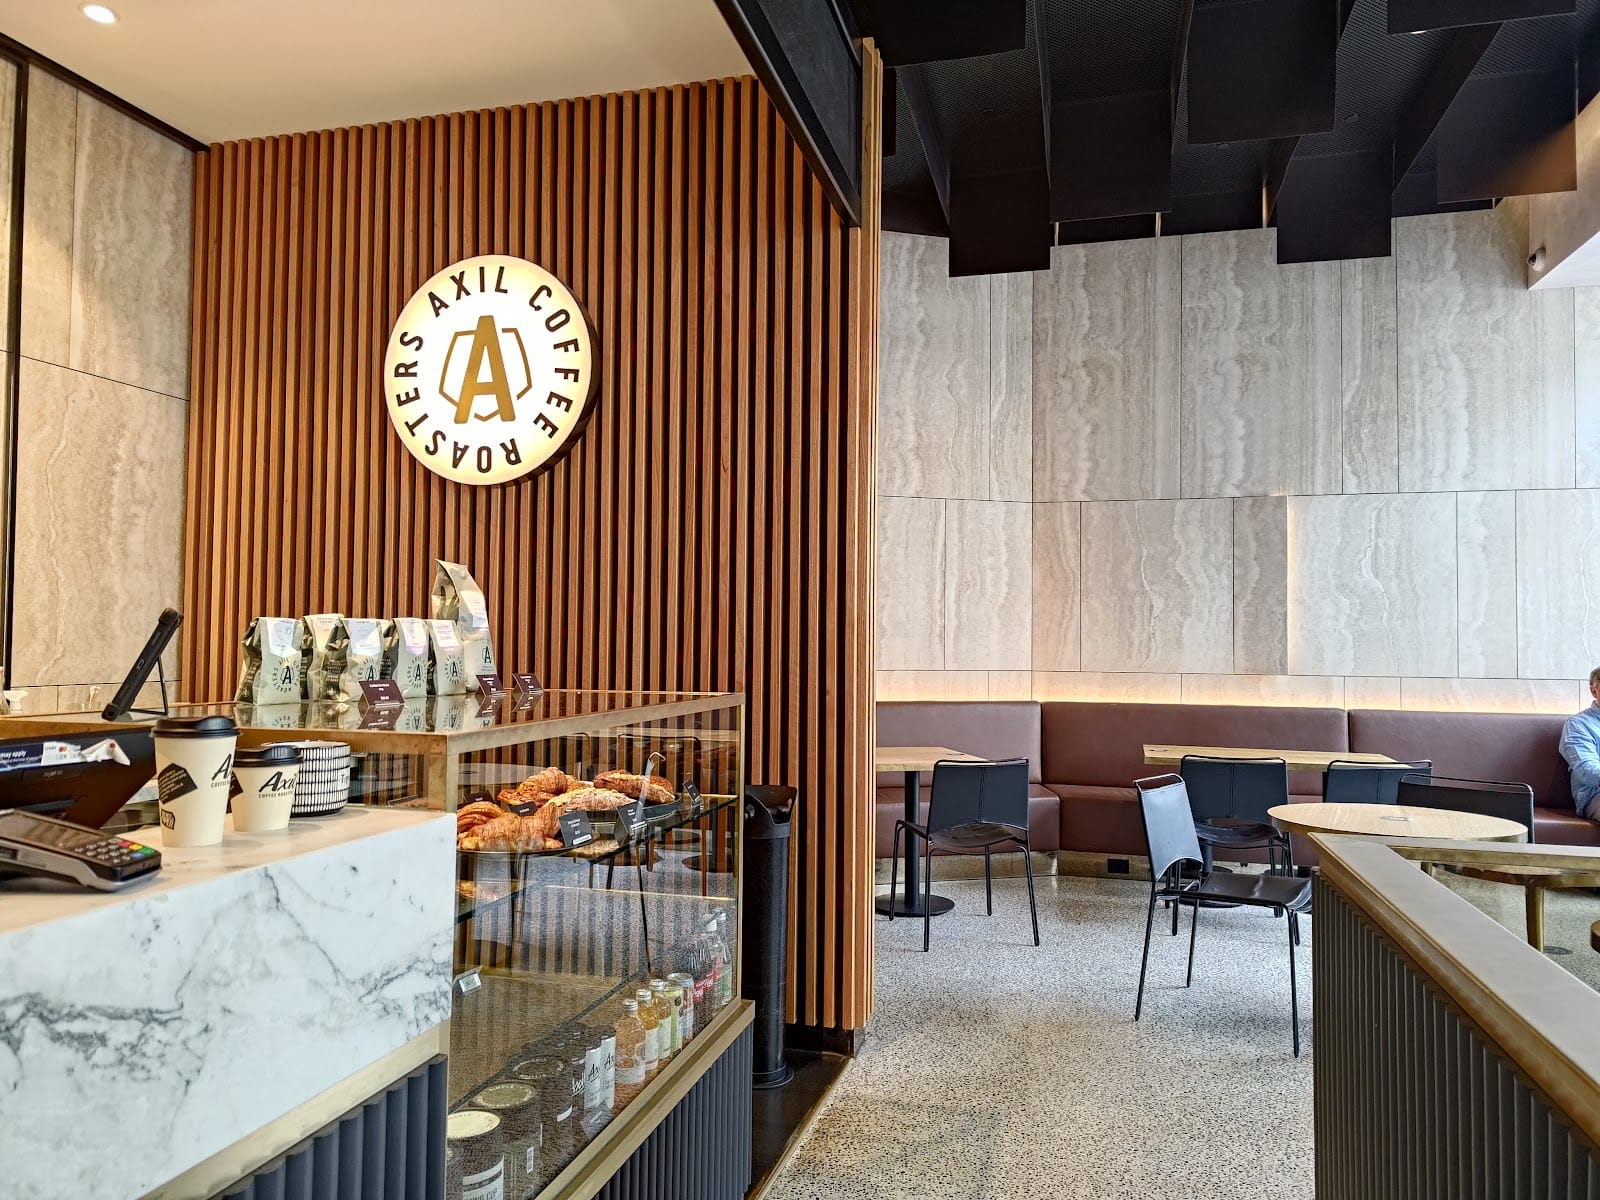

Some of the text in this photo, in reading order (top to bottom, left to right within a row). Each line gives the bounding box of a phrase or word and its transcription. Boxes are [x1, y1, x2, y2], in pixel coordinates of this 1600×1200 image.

[394, 266, 580, 474] AXIL COFFEE ROASTERS
[453, 315, 516, 424] A
[258, 771, 298, 793] Axil
